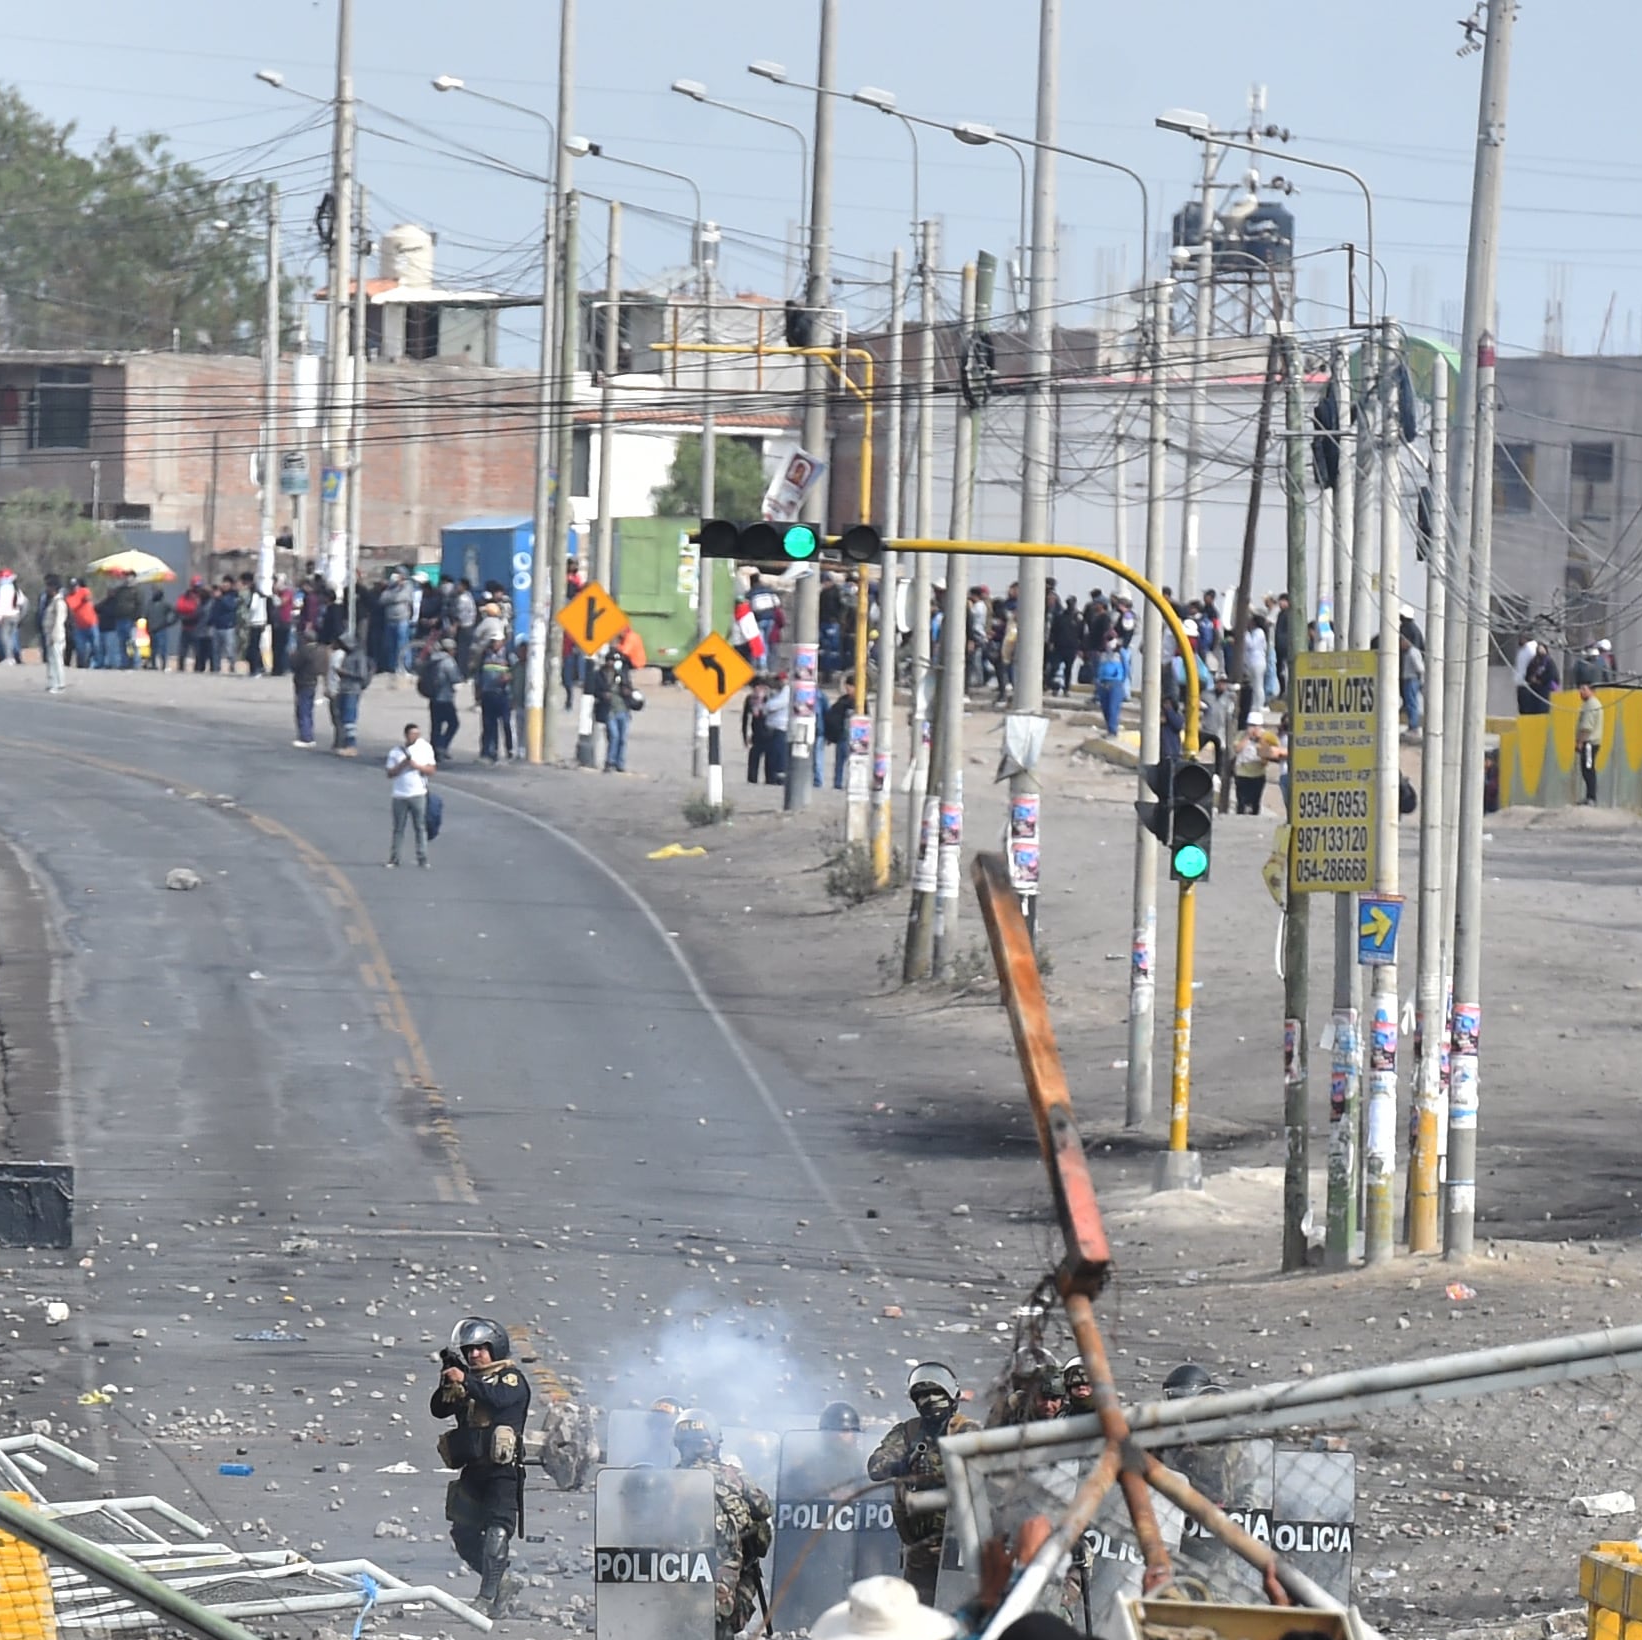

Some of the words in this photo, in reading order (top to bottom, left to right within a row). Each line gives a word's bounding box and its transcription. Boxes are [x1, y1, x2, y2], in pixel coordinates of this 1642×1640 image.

[1297, 678, 1334, 714] VENTA
[1338, 677, 1374, 713] LOTES
[1299, 791, 1368, 818] 959476953
[1297, 826, 1368, 852] 987133120
[597, 1552, 714, 1583] POLICIA
